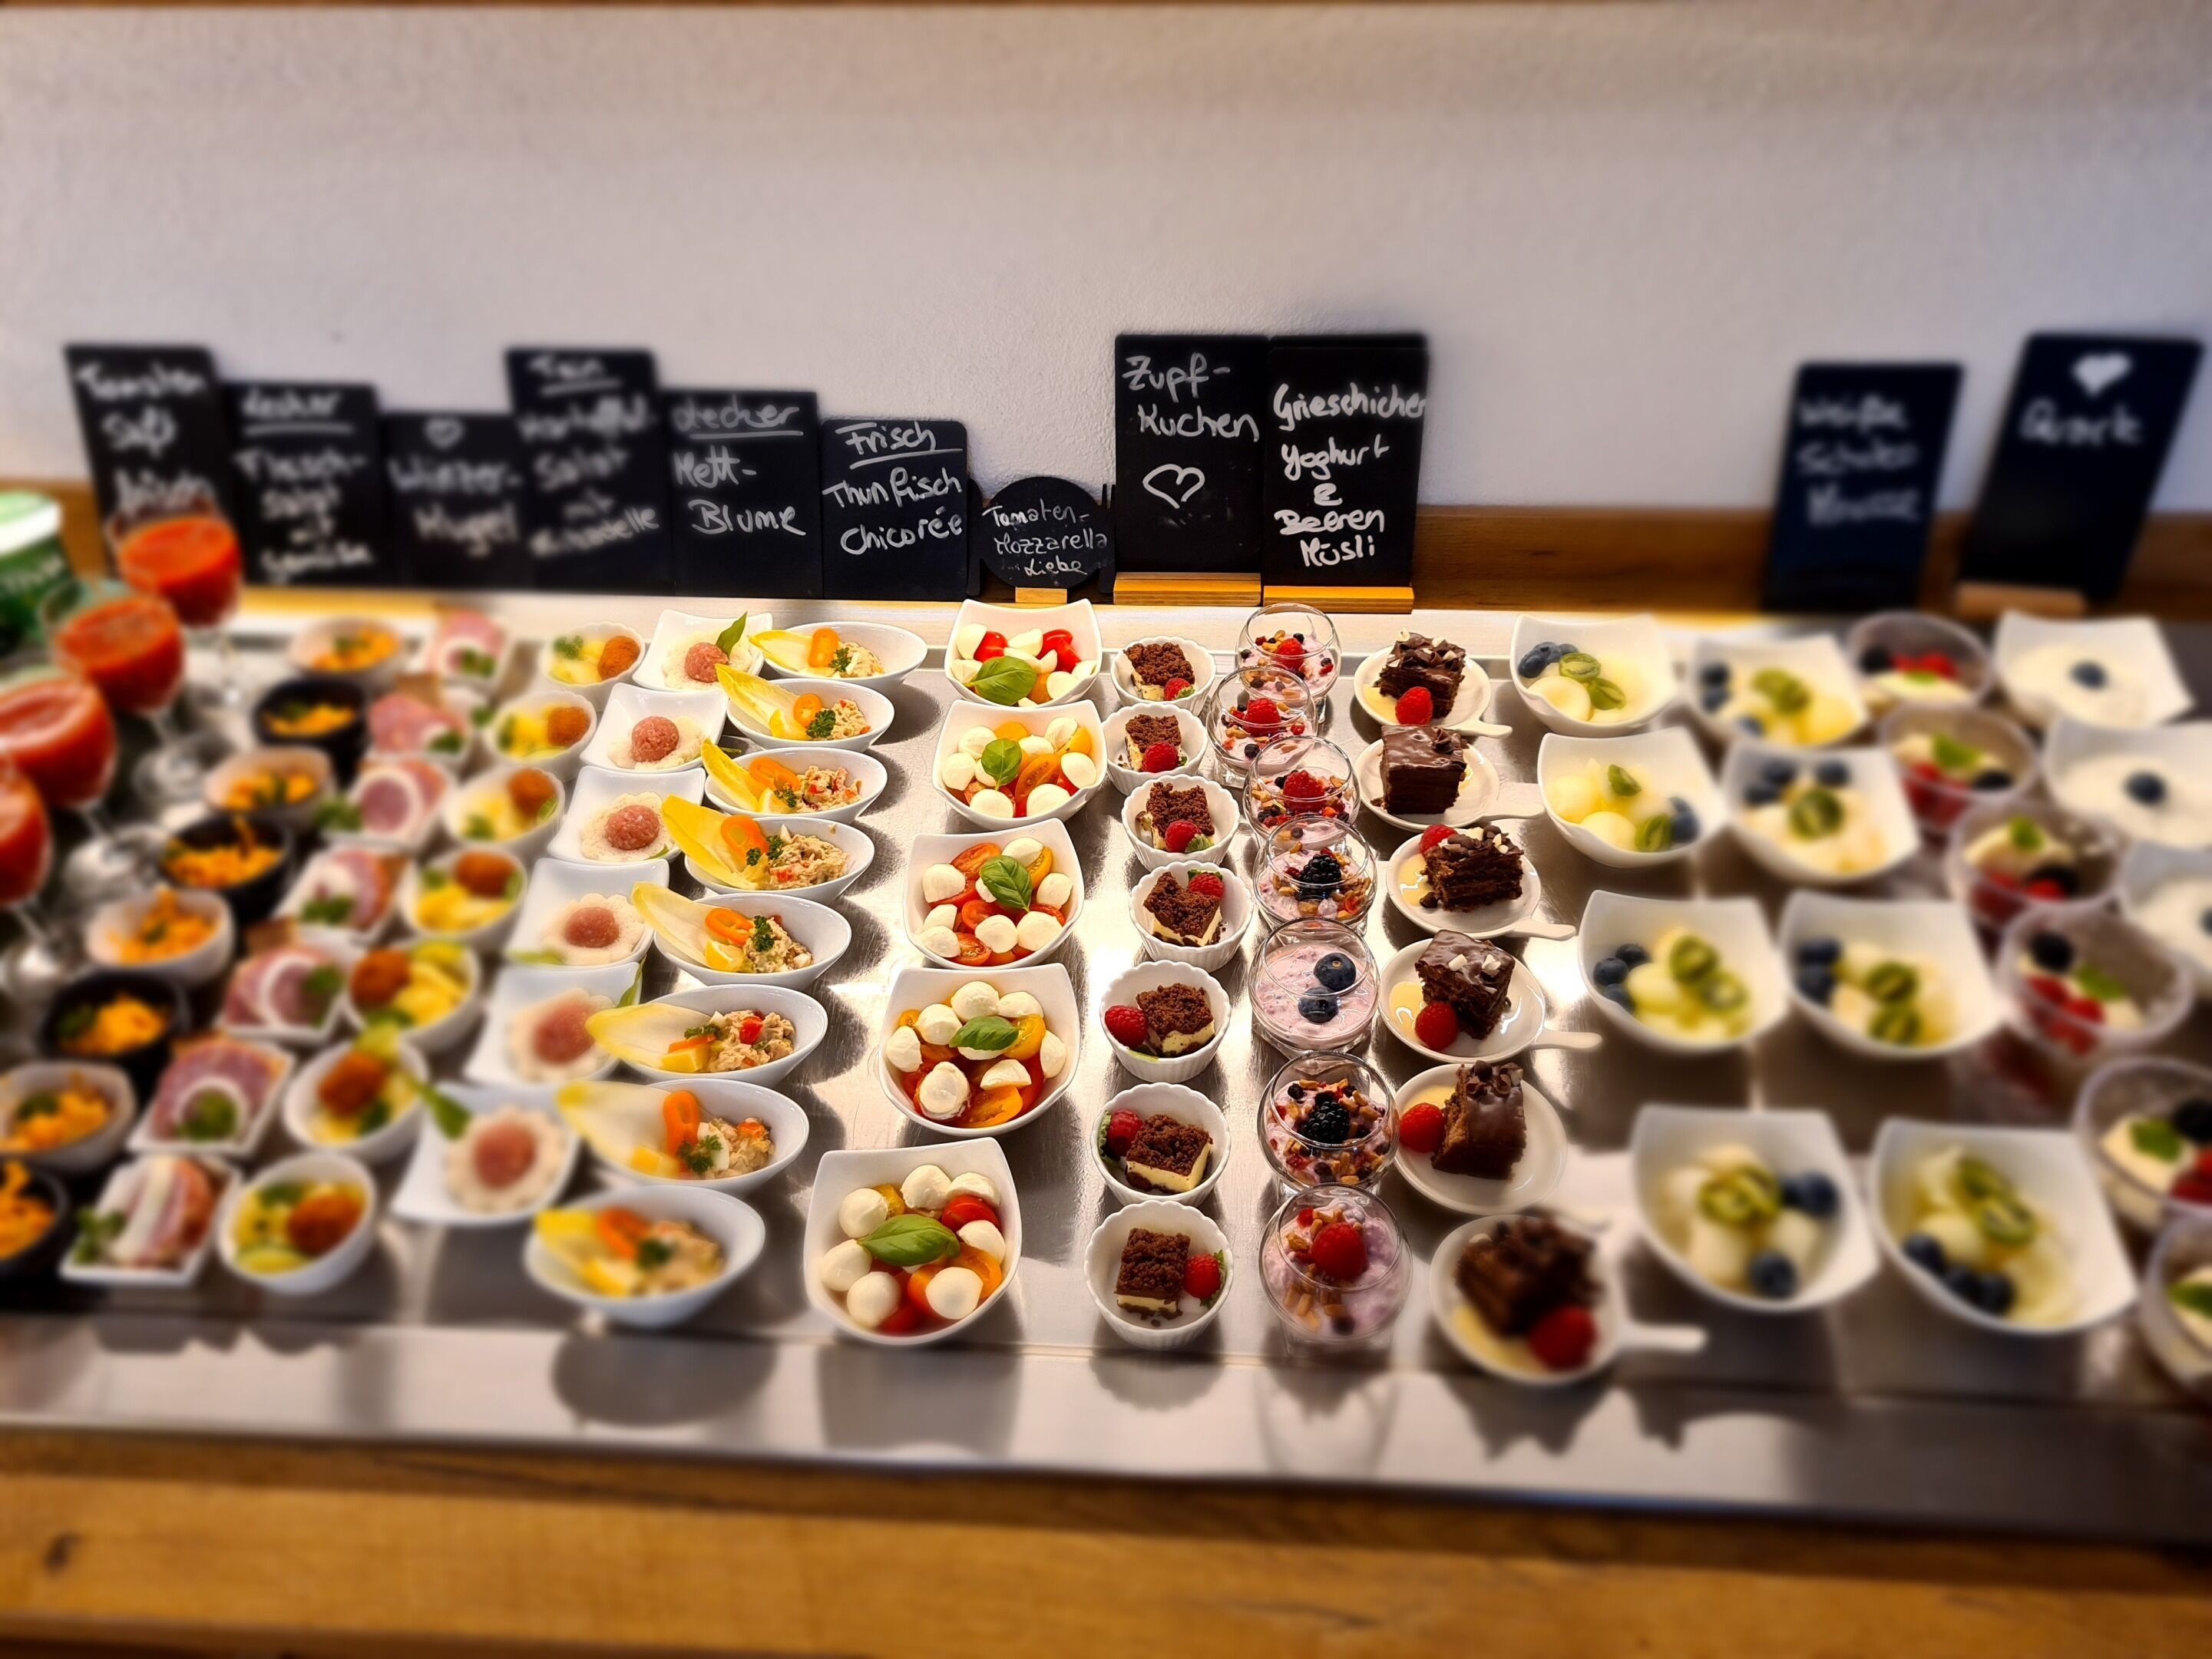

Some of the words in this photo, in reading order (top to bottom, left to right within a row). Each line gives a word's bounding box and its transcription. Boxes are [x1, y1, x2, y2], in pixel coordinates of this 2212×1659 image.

[1122, 352, 1231, 403] Zupf-
[835, 421, 937, 455] Frisch
[1138, 405, 1259, 442] Kuchen
[674, 444, 757, 489] Mett-
[688, 500, 806, 536] Blume
[840, 506, 962, 555] Chicorée
[1274, 509, 1385, 535] Beeren
[994, 528, 1108, 555] Mozzarella
[1300, 534, 1375, 567] Müsli
[1023, 555, 1088, 577] Liebe
